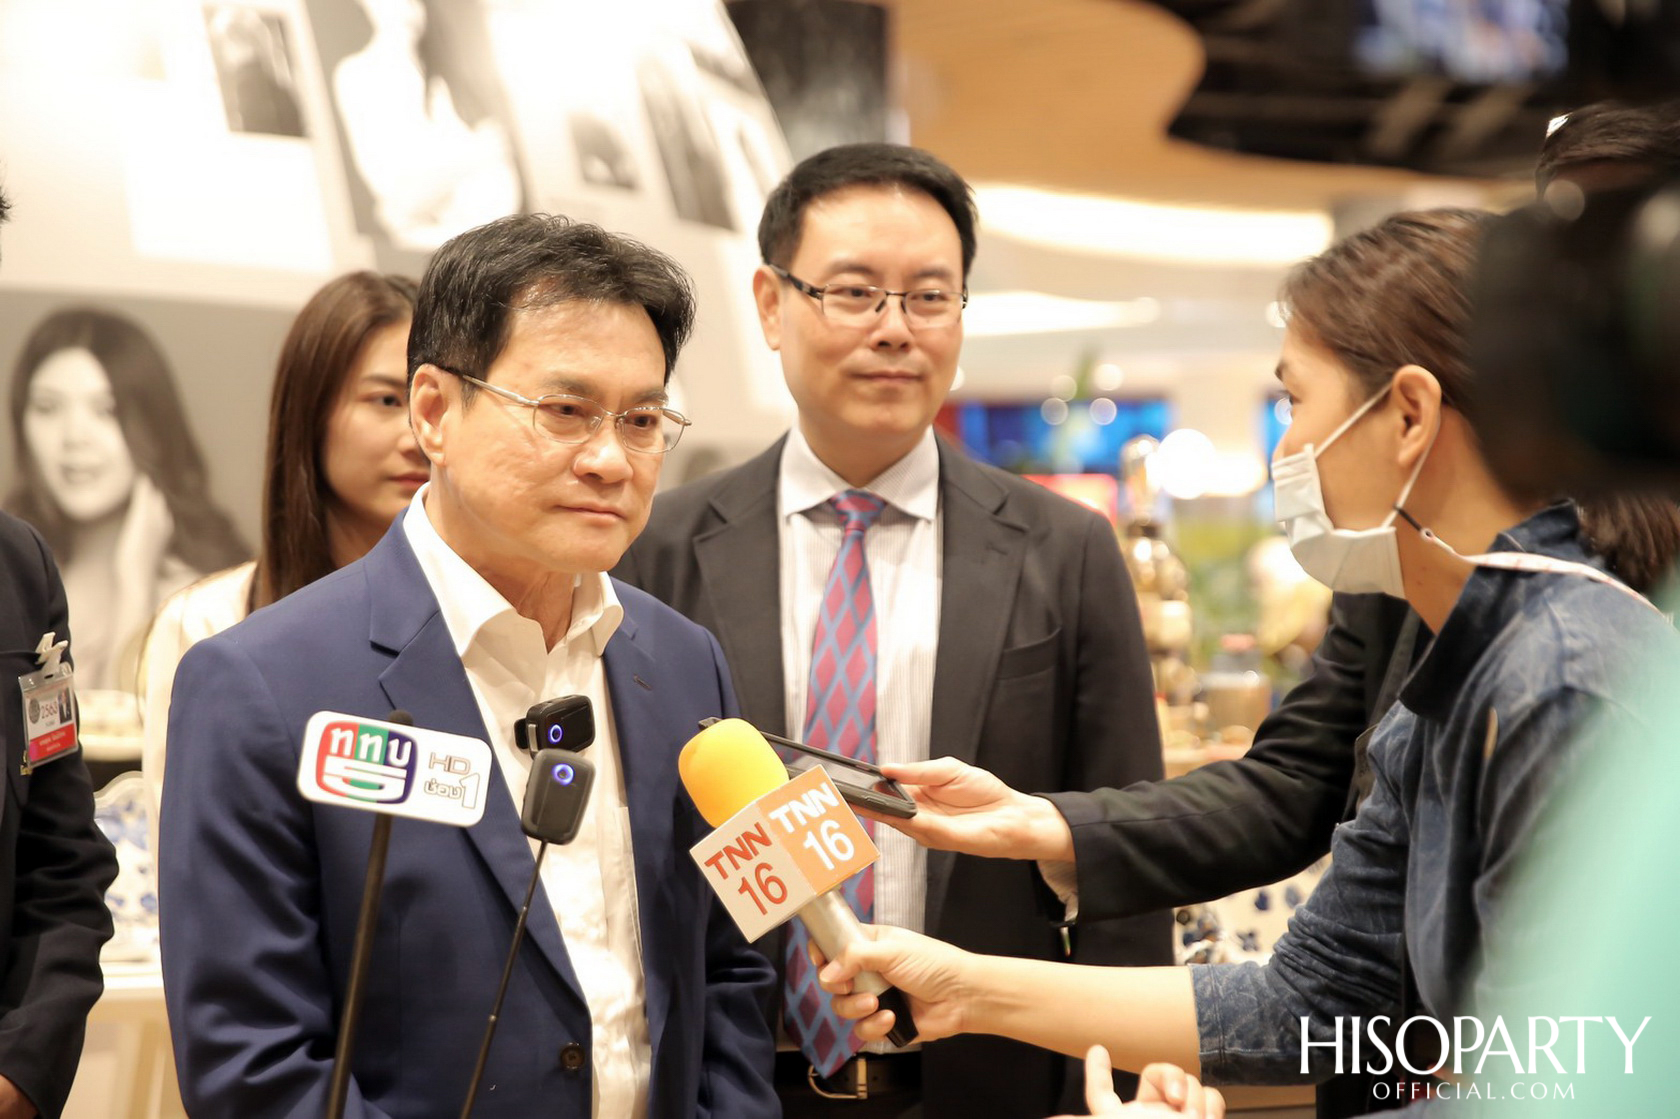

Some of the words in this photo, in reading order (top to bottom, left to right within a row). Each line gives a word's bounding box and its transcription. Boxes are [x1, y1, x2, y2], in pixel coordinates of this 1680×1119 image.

[429, 752, 470, 775] HD
[769, 782, 839, 833] TNN
[704, 822, 772, 880] TNN
[804, 820, 855, 870] 16
[738, 862, 788, 915] 16
